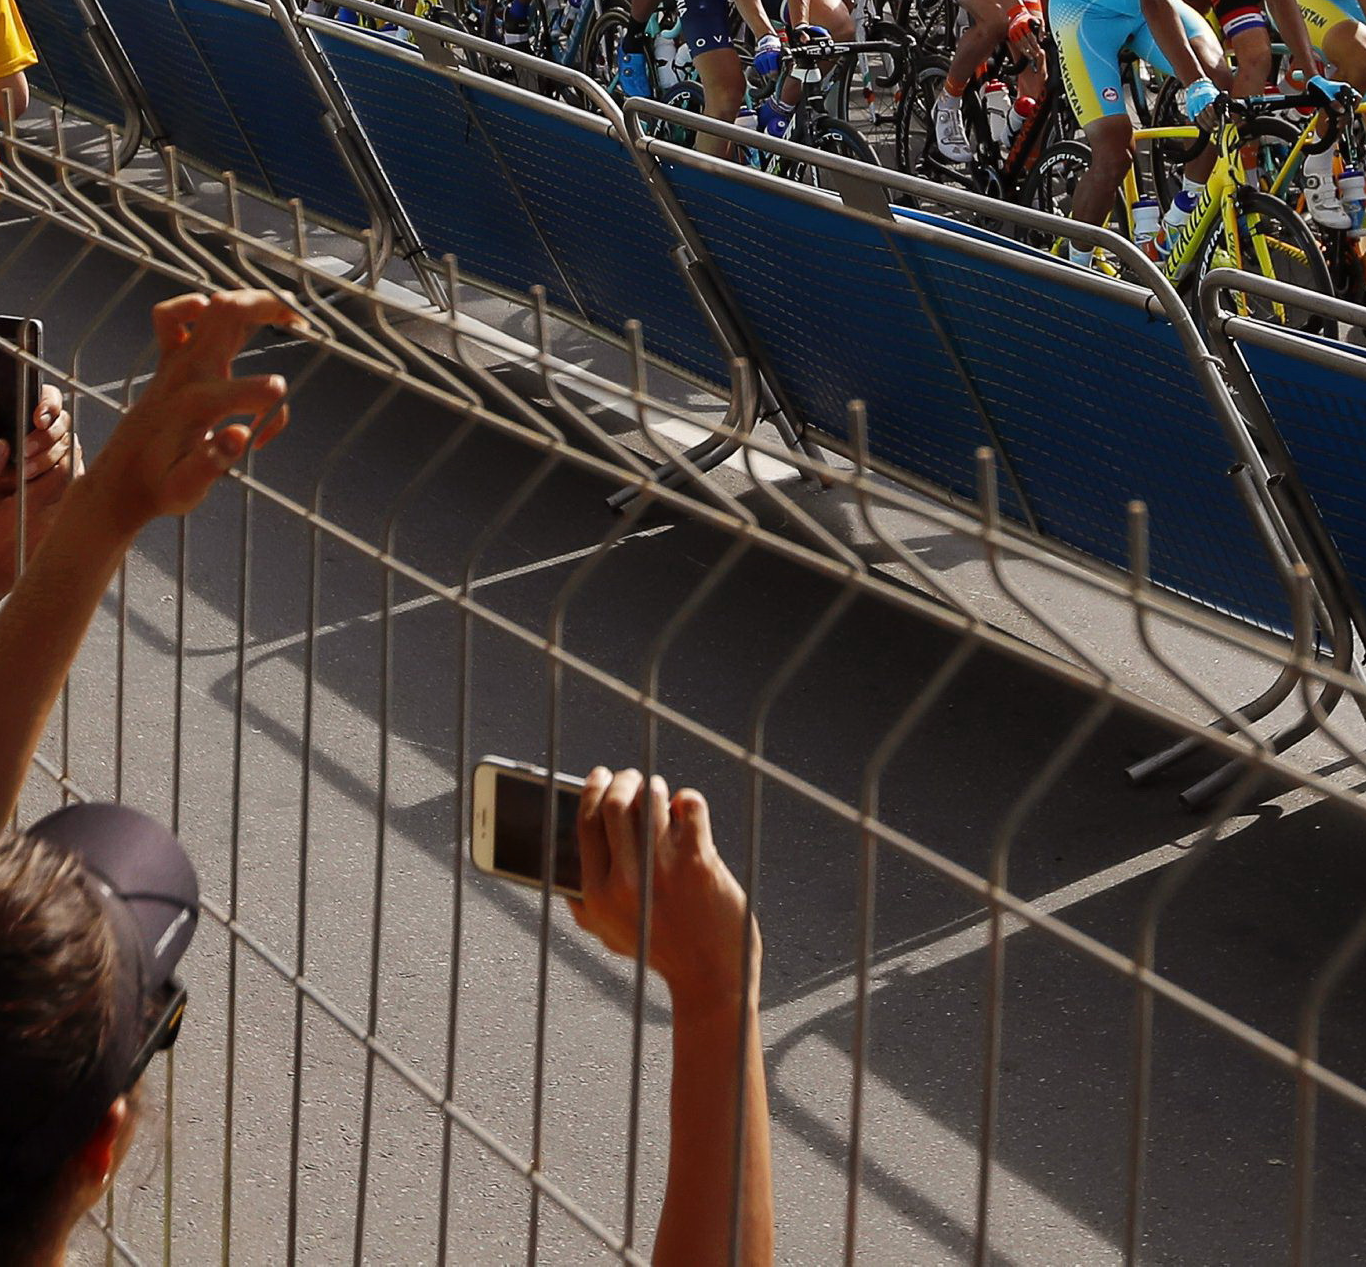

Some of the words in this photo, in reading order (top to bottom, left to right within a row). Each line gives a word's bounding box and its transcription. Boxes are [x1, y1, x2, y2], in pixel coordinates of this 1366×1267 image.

[1055, 30, 1083, 117] KAZAKHSTAN
[1164, 186, 1212, 280] ECIALIZED
[1199, 221, 1225, 281] ORIM
